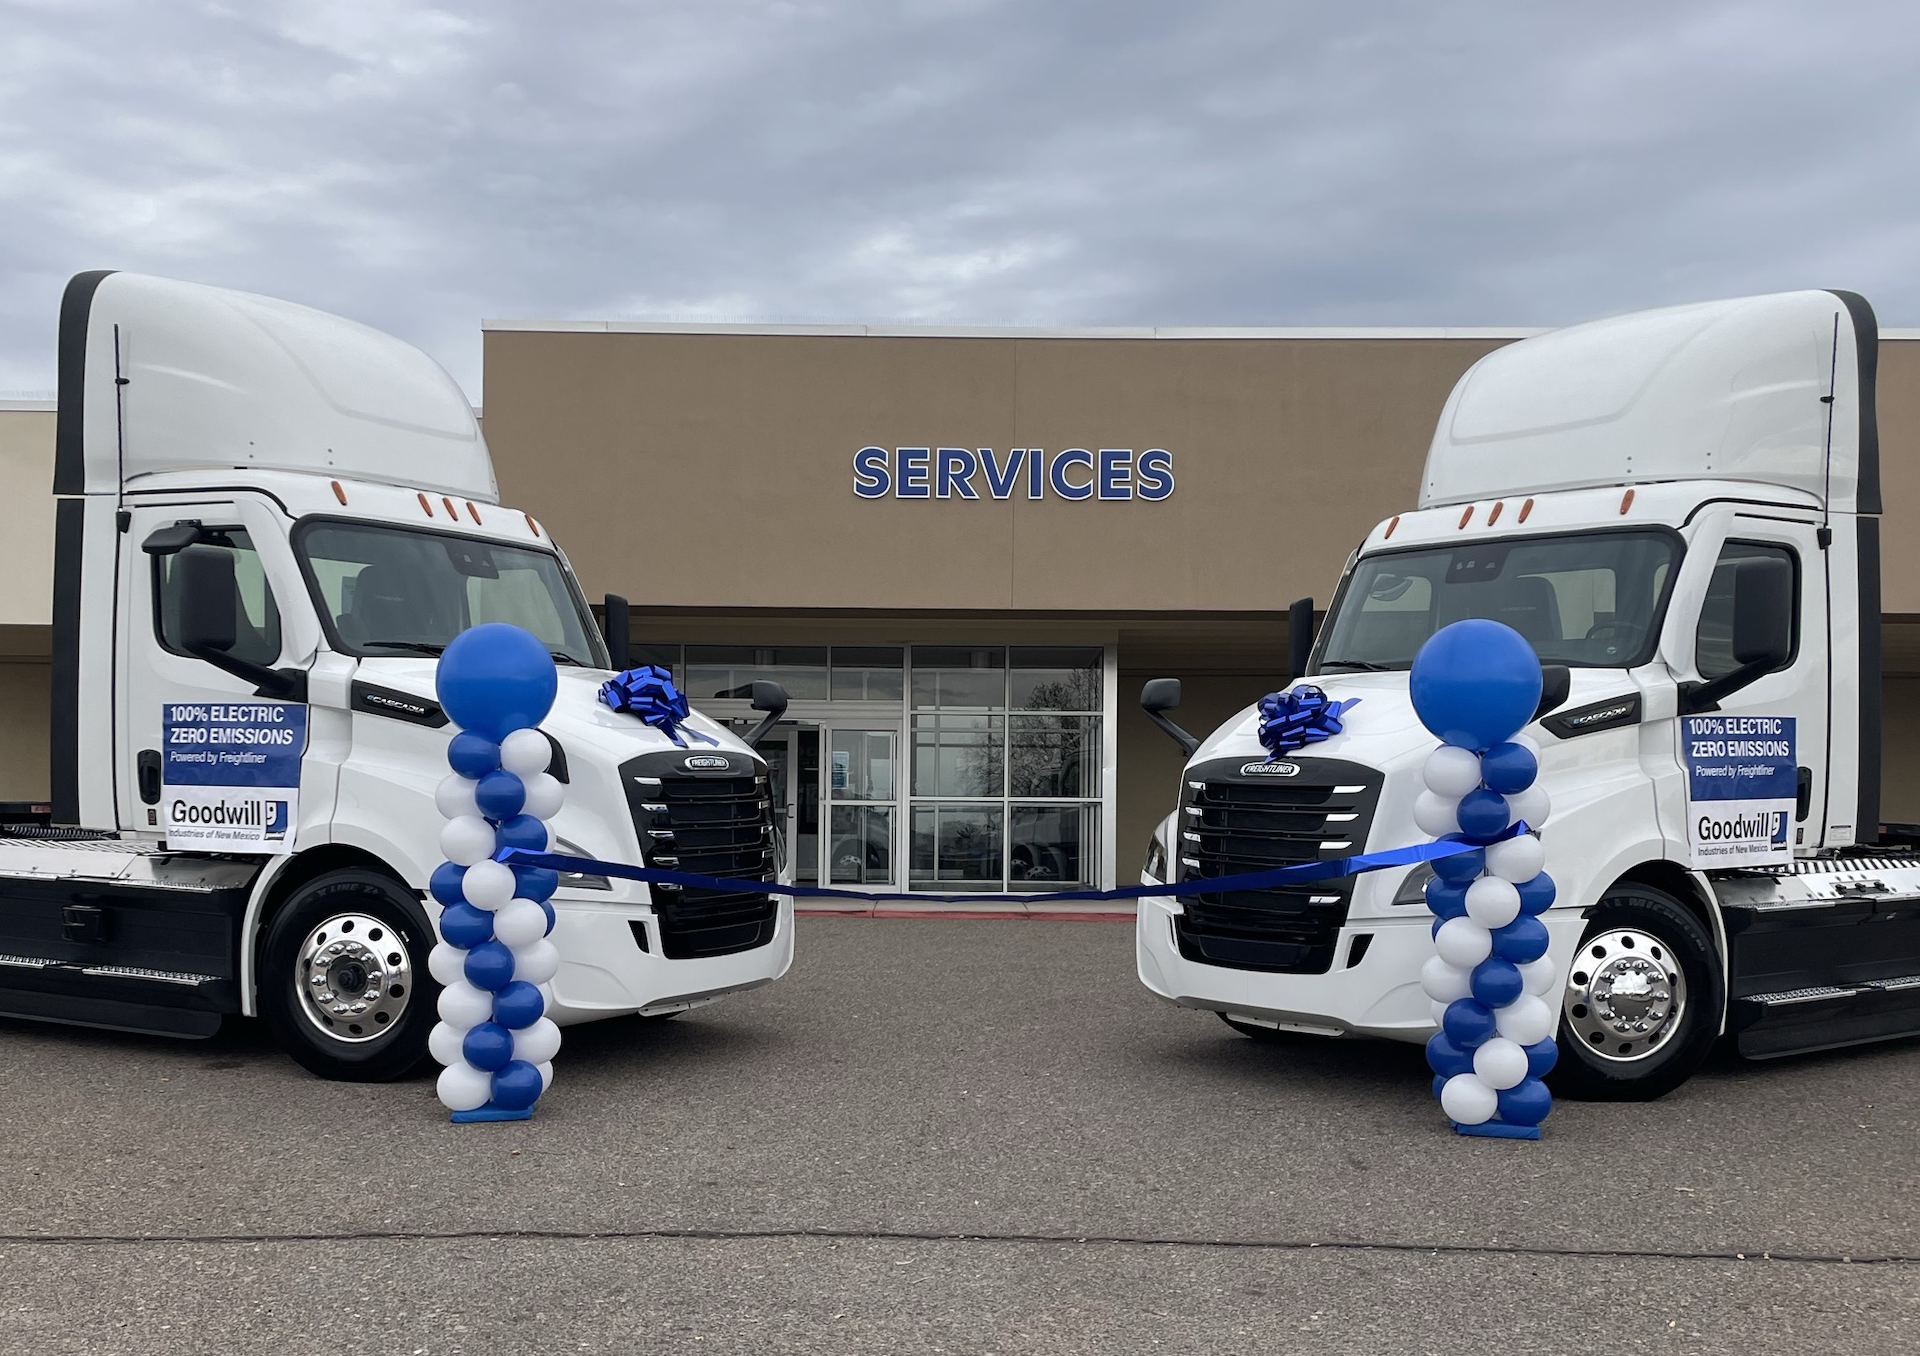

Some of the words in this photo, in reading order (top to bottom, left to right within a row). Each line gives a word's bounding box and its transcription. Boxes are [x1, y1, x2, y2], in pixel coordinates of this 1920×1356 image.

[853, 446, 1175, 501] SERVICES
[170, 706, 208, 722] 100%
[210, 706, 285, 722] ELECTRIC
[1689, 718, 1724, 735] 100%
[1726, 718, 1782, 735] ELECTRIC
[170, 728, 208, 743] ZERO
[209, 728, 294, 744] EMISSIONS
[1692, 741, 1726, 757] ZERO
[1727, 740, 1789, 757] EMISSIONS
[170, 751, 206, 763] Powered
[207, 752, 218, 766] by
[219, 751, 267, 766] Freightliner
[1696, 765, 1727, 777] Powered
[1728, 765, 1737, 779] by
[1737, 765, 1775, 779] Freightliner
[172, 799, 261, 826] Goodwill
[168, 828, 204, 838] Industries
[205, 829, 214, 838] of
[214, 830, 231, 839] New
[232, 831, 260, 840] Mexico
[1698, 812, 1770, 841] Goodwill
[1698, 845, 1729, 857] Industries
[1729, 845, 1735, 855] of
[1735, 845, 1749, 854] New
[1749, 844, 1769, 853] Mexico
